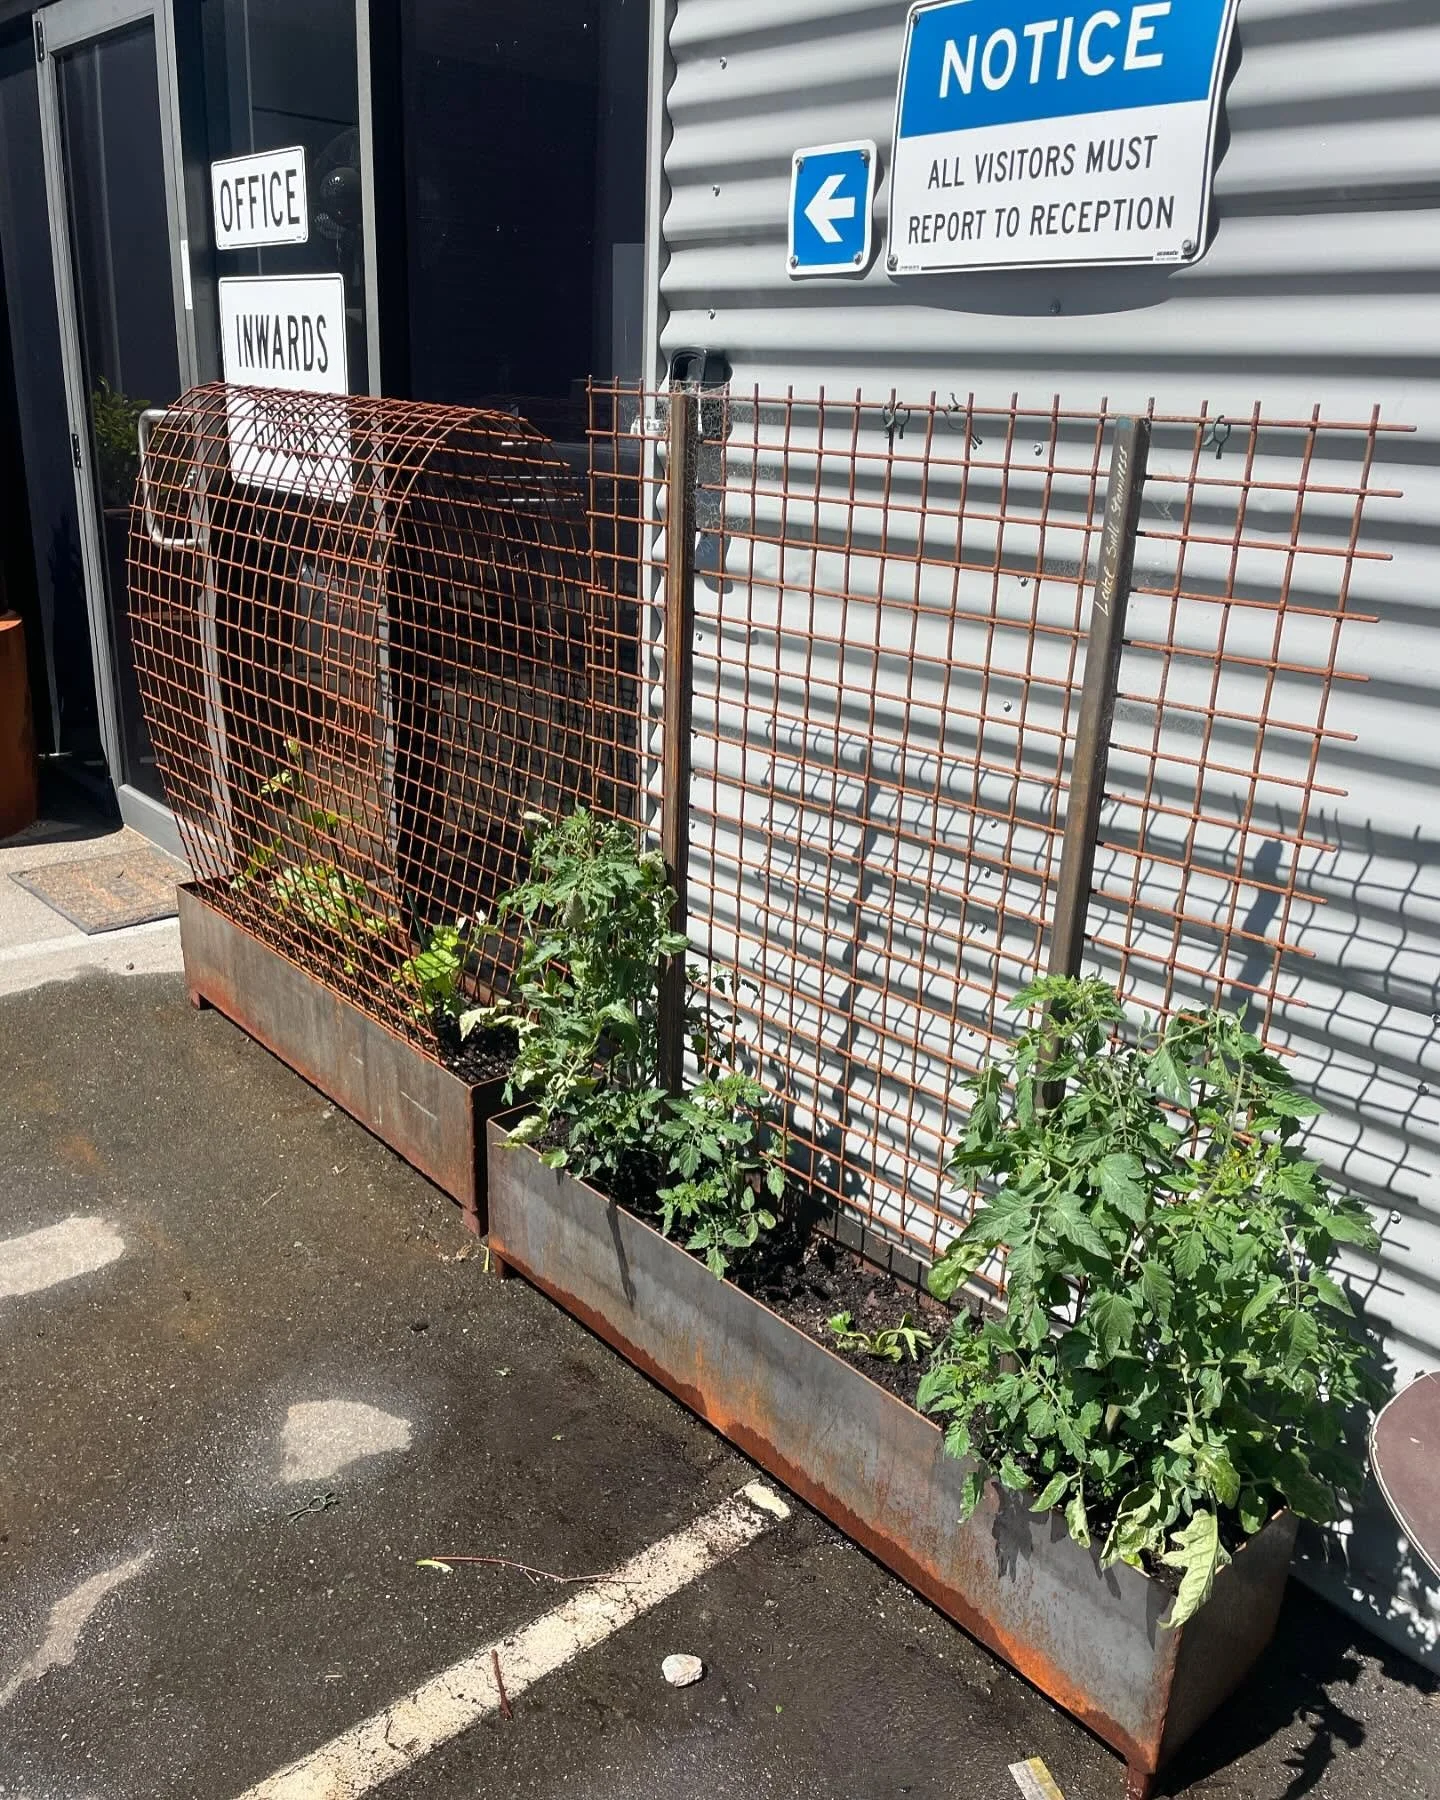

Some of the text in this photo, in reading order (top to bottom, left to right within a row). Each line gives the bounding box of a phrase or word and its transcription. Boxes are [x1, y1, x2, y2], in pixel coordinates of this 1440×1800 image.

[939, 1, 1171, 98] NOTICE
[927, 135, 1158, 189] ALL VISITORS MUST
[220, 169, 300, 232] OFFICE
[908, 196, 1175, 244] REPORT TO RECEPTION
[236, 314, 329, 373] INWARDS
